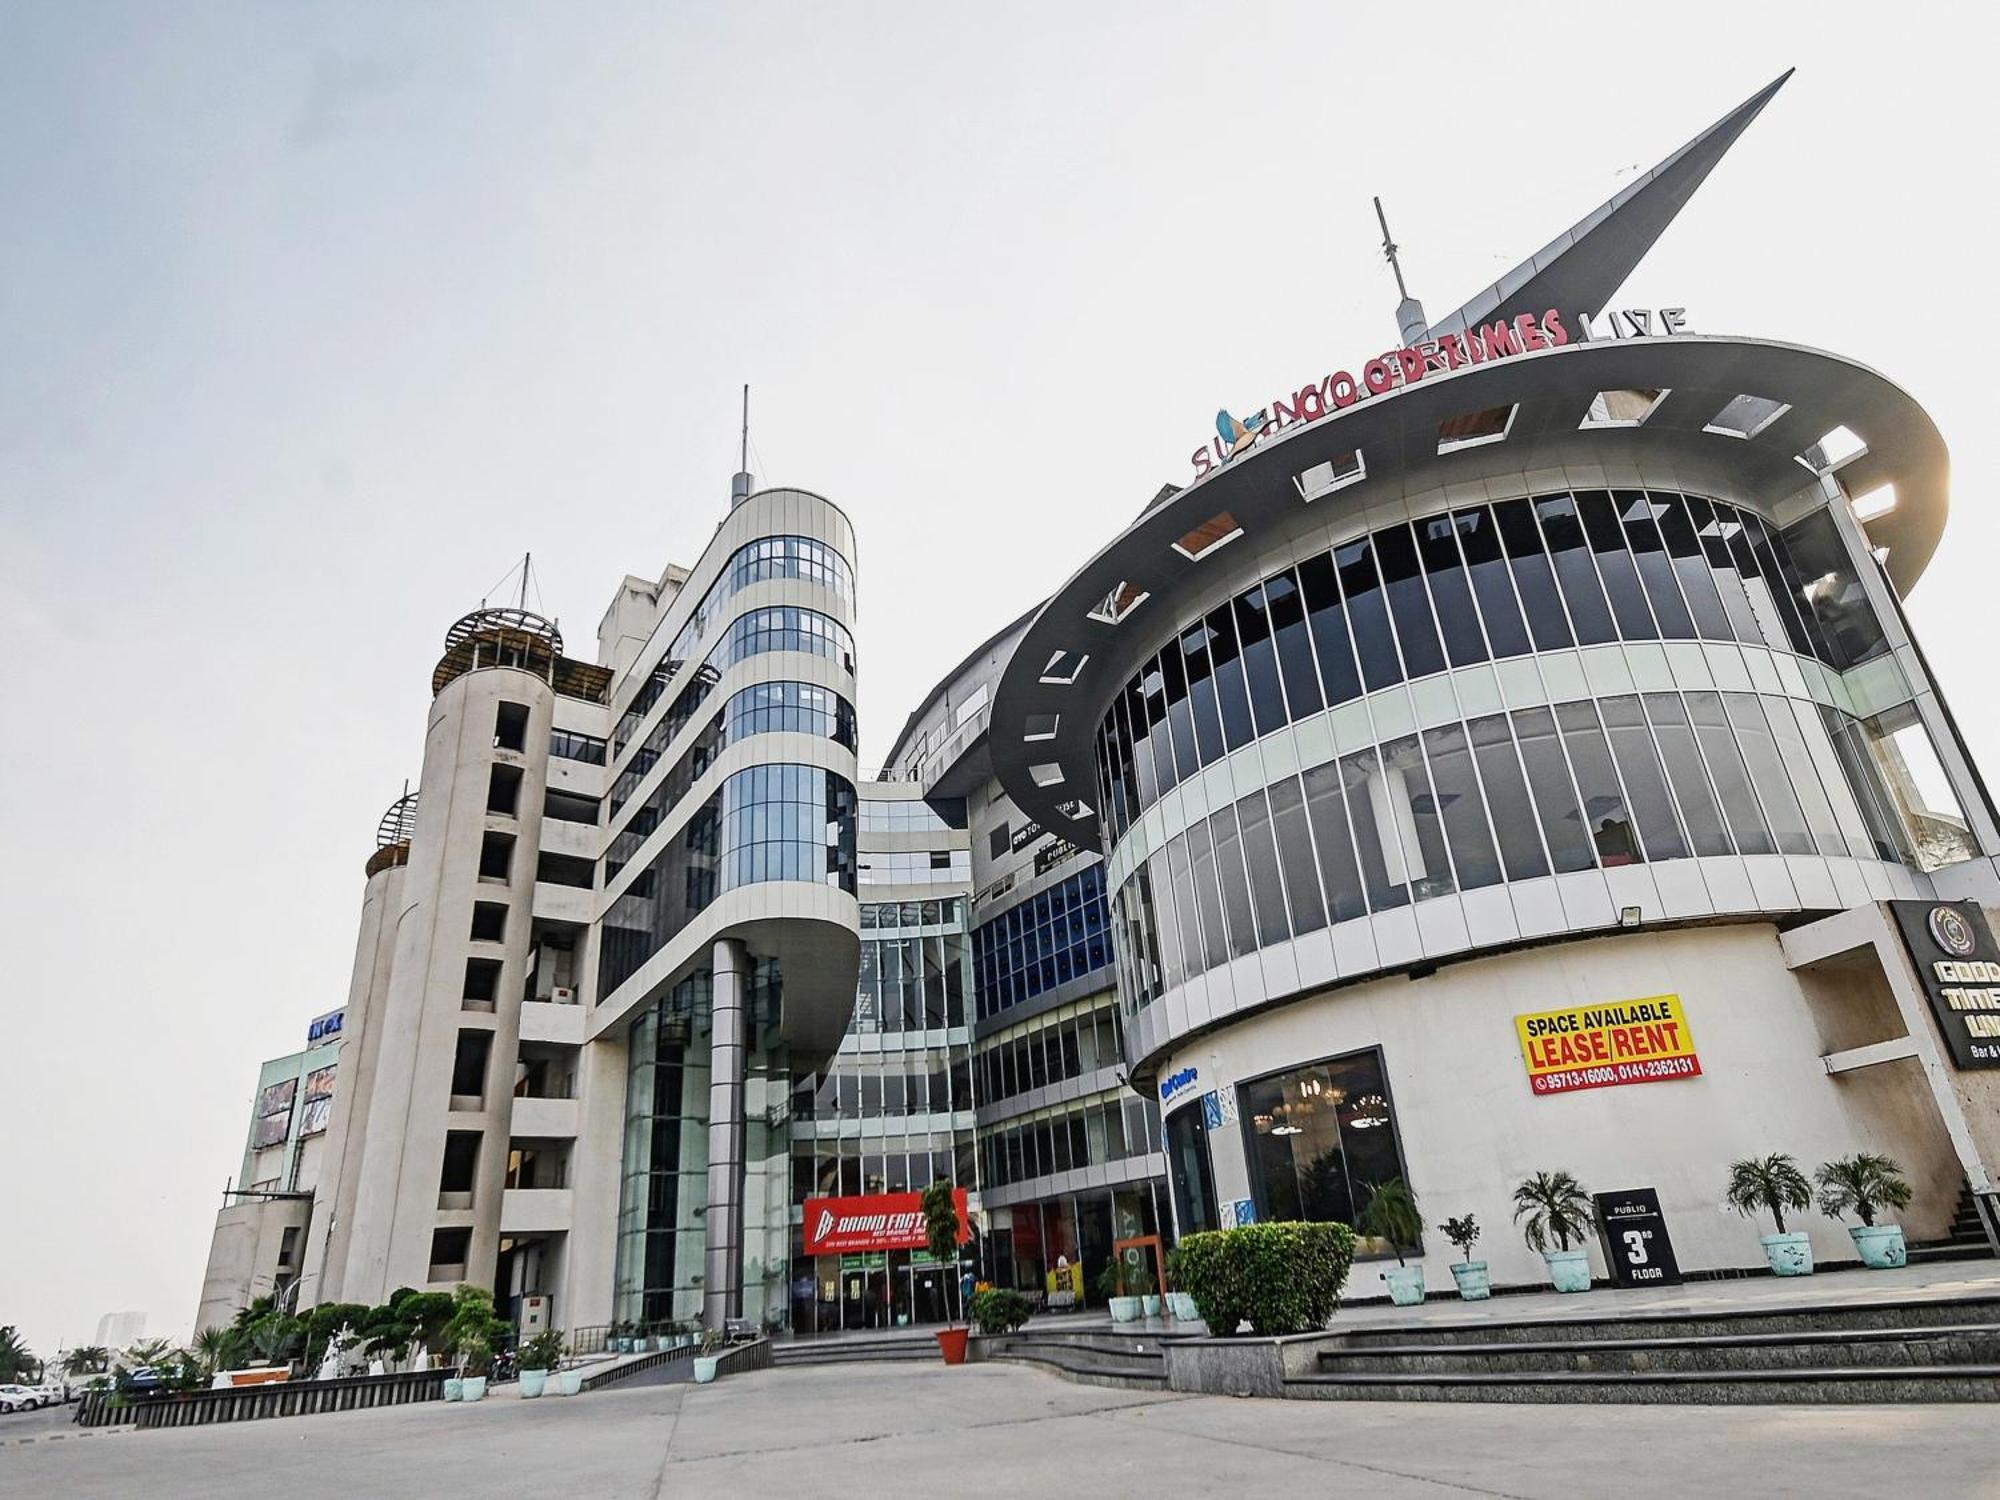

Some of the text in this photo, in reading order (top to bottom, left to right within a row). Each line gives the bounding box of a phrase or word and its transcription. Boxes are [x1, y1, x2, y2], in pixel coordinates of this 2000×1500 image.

[1438, 308, 1568, 370] TIMES
[1579, 307, 1695, 342] LIVE
[1932, 961, 2000, 982] GOOD
[1527, 1002, 1672, 1037] SPACE AVAILABLE
[837, 1214, 886, 1232] BRAND
[1631, 1268, 1663, 1280] FLOOR
